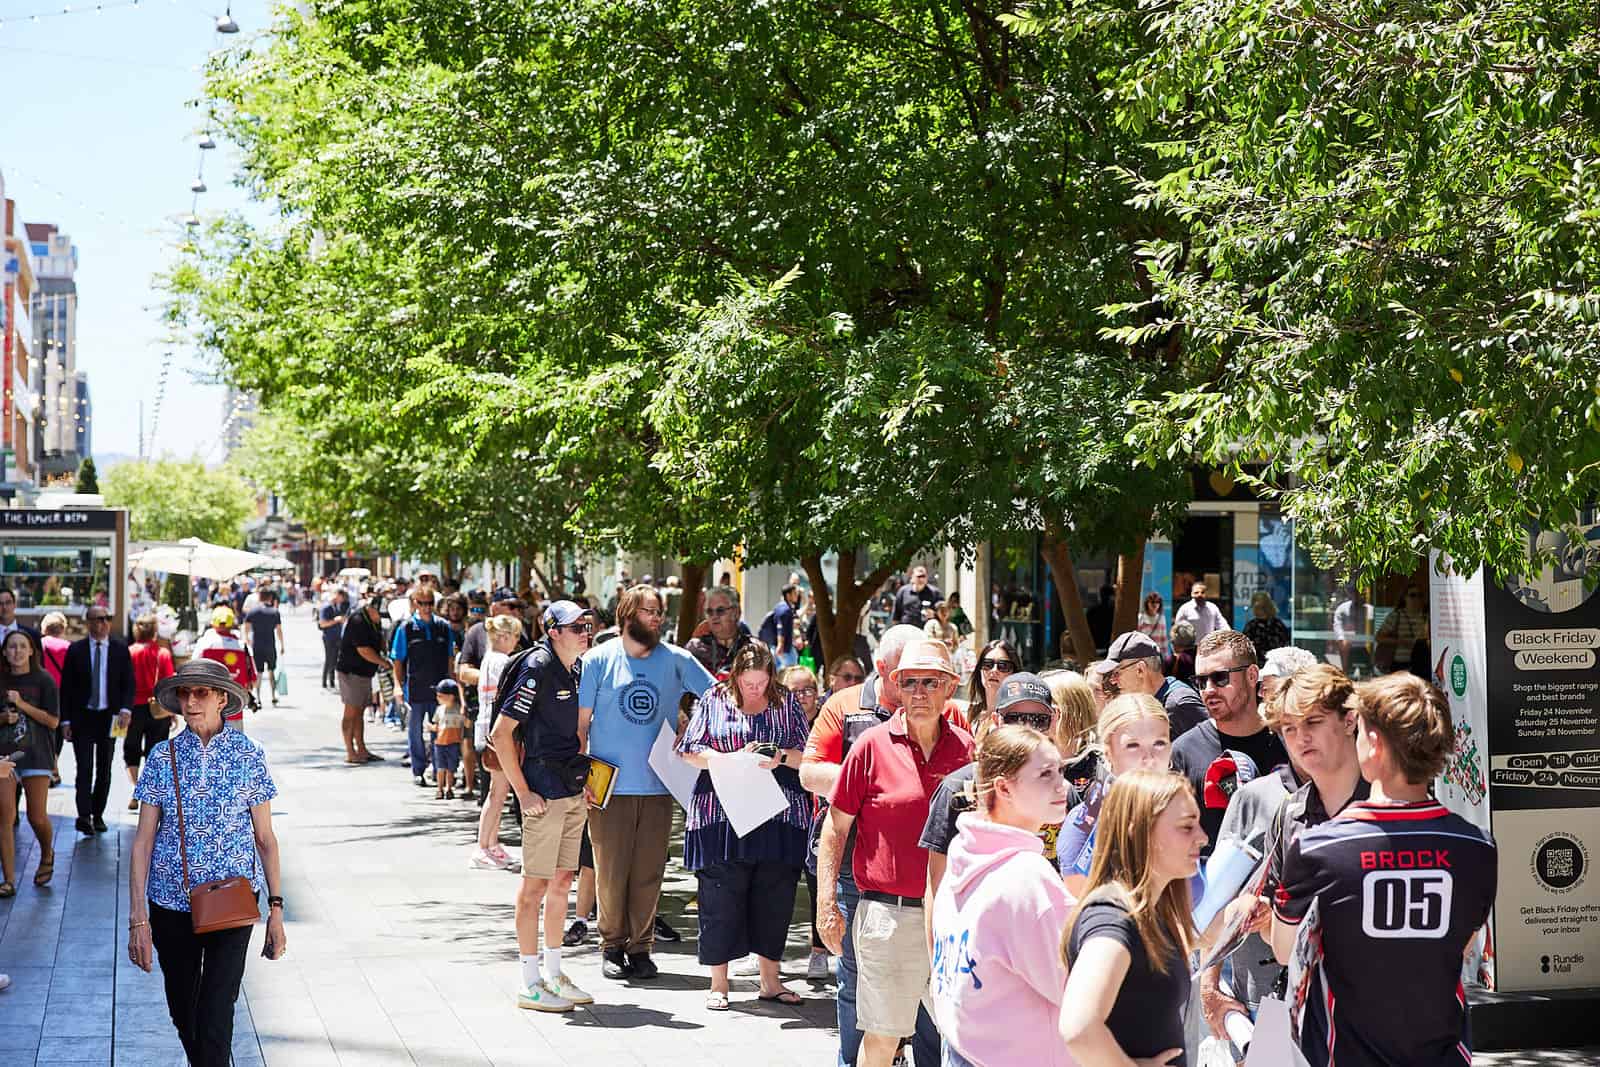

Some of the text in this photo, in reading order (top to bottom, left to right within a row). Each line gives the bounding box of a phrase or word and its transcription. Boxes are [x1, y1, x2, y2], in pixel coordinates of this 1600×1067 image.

[1512, 631, 1596, 645] Black Friday
[1522, 651, 1588, 664] Weekend
[1512, 682, 1599, 692] Shop the biggest range
[1526, 692, 1585, 701] and best brands
[1519, 708, 1542, 717] Friday
[1554, 707, 1592, 715] November
[1514, 717, 1598, 728] Saturday 25 November
[1518, 728, 1546, 738] Sunday
[1512, 758, 1543, 769] Open
[1495, 770, 1529, 783] Friday
[1539, 772, 1553, 782] 24
[1360, 849, 1452, 869] BROCK
[1372, 877, 1444, 931] 05
[1520, 906, 1534, 915] Get
[1535, 905, 1555, 914] Black
[1556, 905, 1579, 914] Friday
[1524, 916, 1559, 925] delivered
[1560, 915, 1588, 925] straight
[1542, 927, 1559, 936] your
[1553, 953, 1584, 964] Rundle
[1553, 963, 1572, 973] Mall
